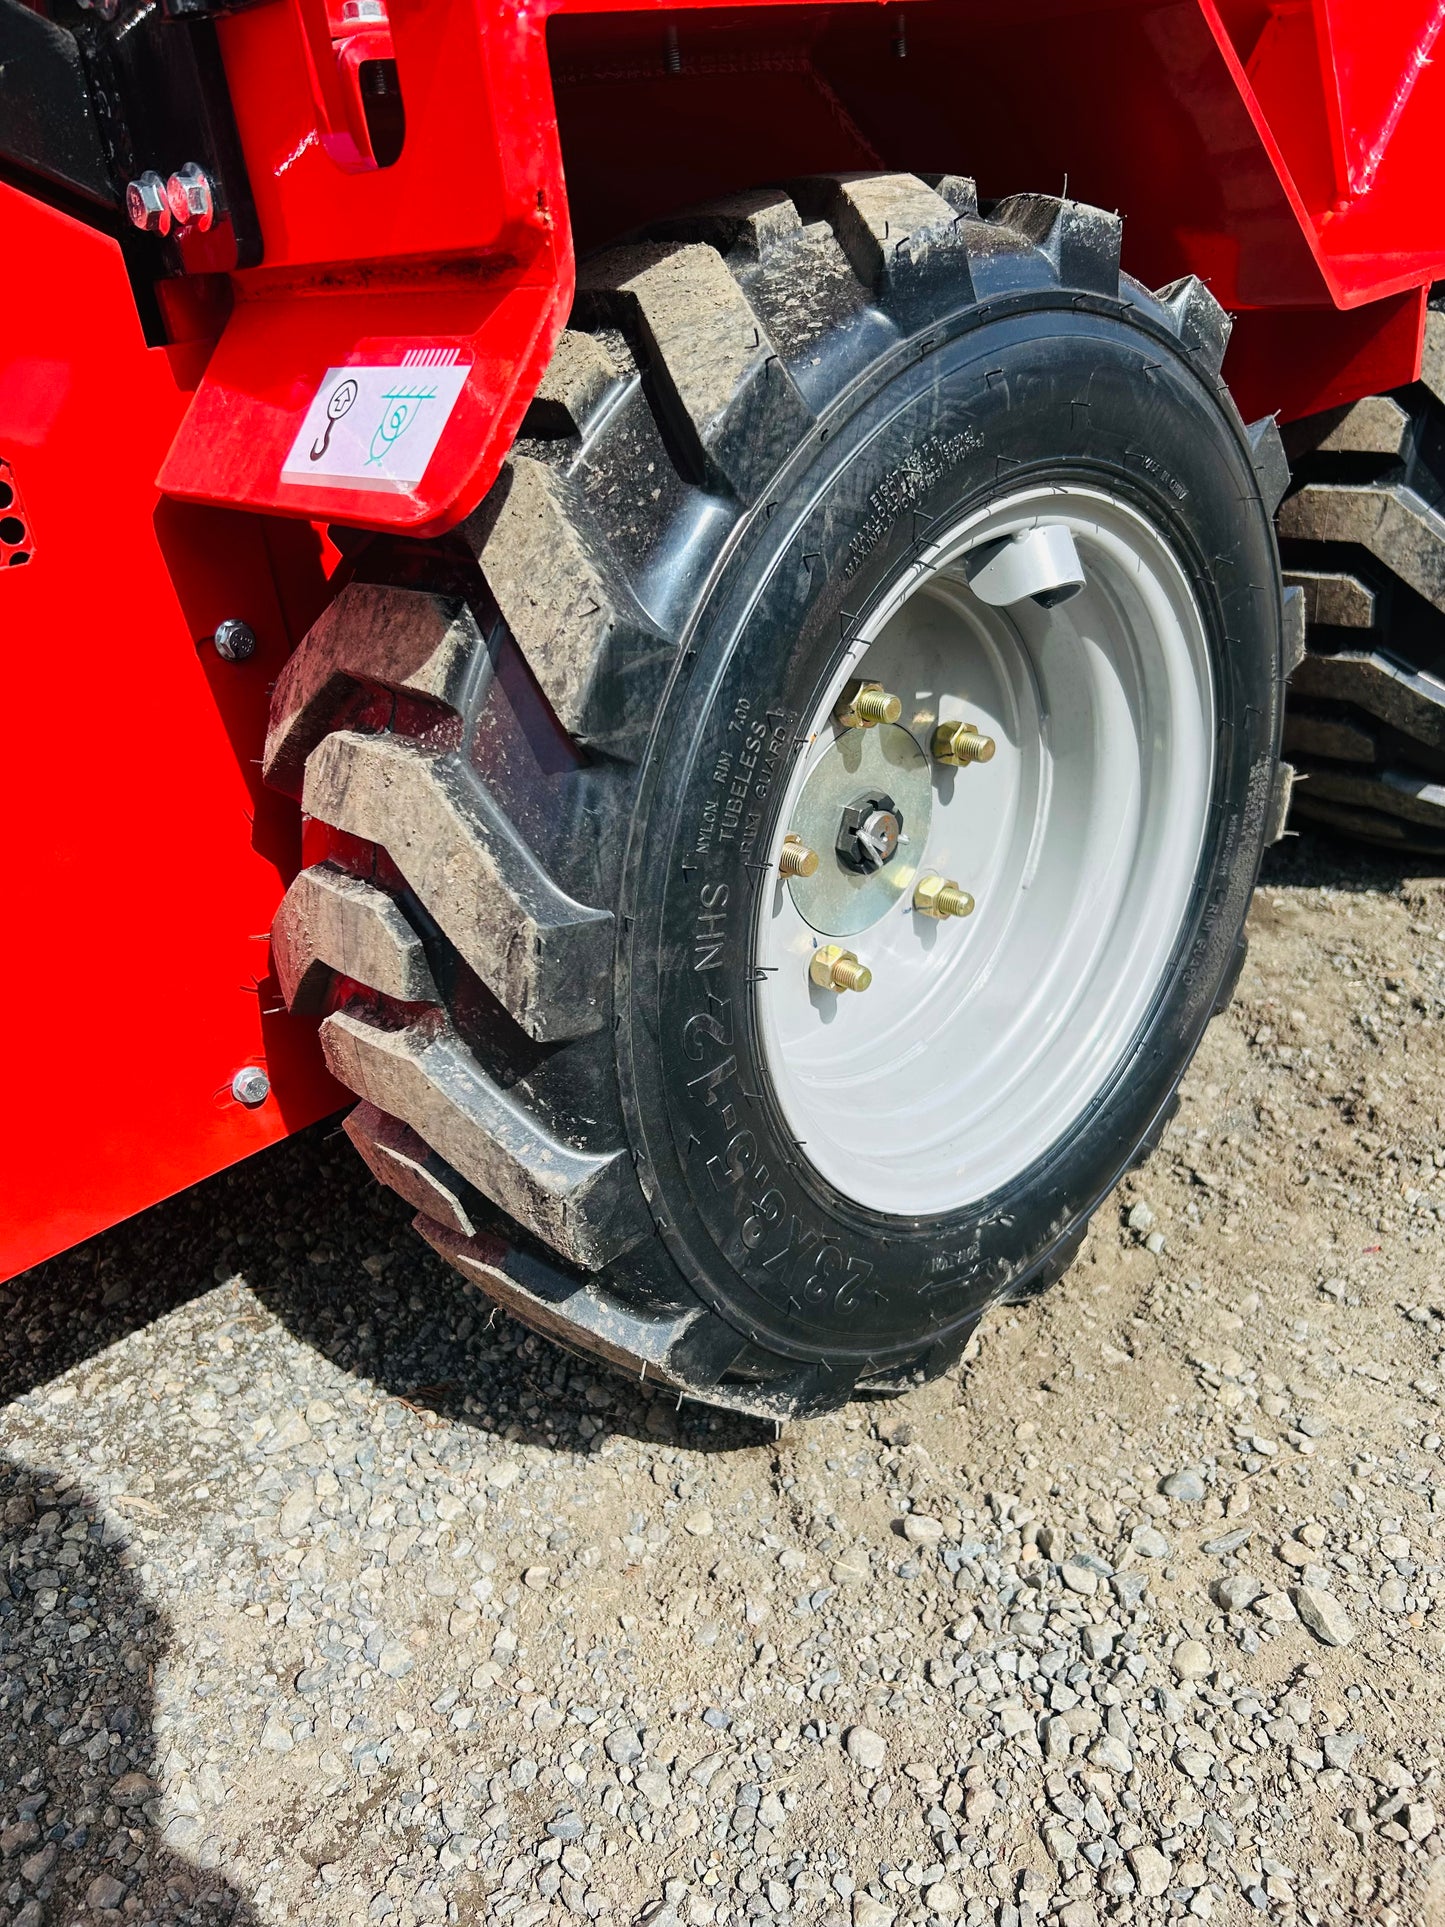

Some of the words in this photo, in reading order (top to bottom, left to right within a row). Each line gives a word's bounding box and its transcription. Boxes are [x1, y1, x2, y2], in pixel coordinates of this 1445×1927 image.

[695, 800, 720, 856] NYLON
[713, 751, 734, 784] RIM
[728, 698, 752, 733] 7.00
[718, 720, 768, 843] TUBELESS
[739, 813, 761, 855] RIM
[755, 726, 788, 800] GUARD
[694, 882, 730, 973] NHS
[1182, 937, 1208, 988] GUARD
[1202, 902, 1219, 933] RIM
